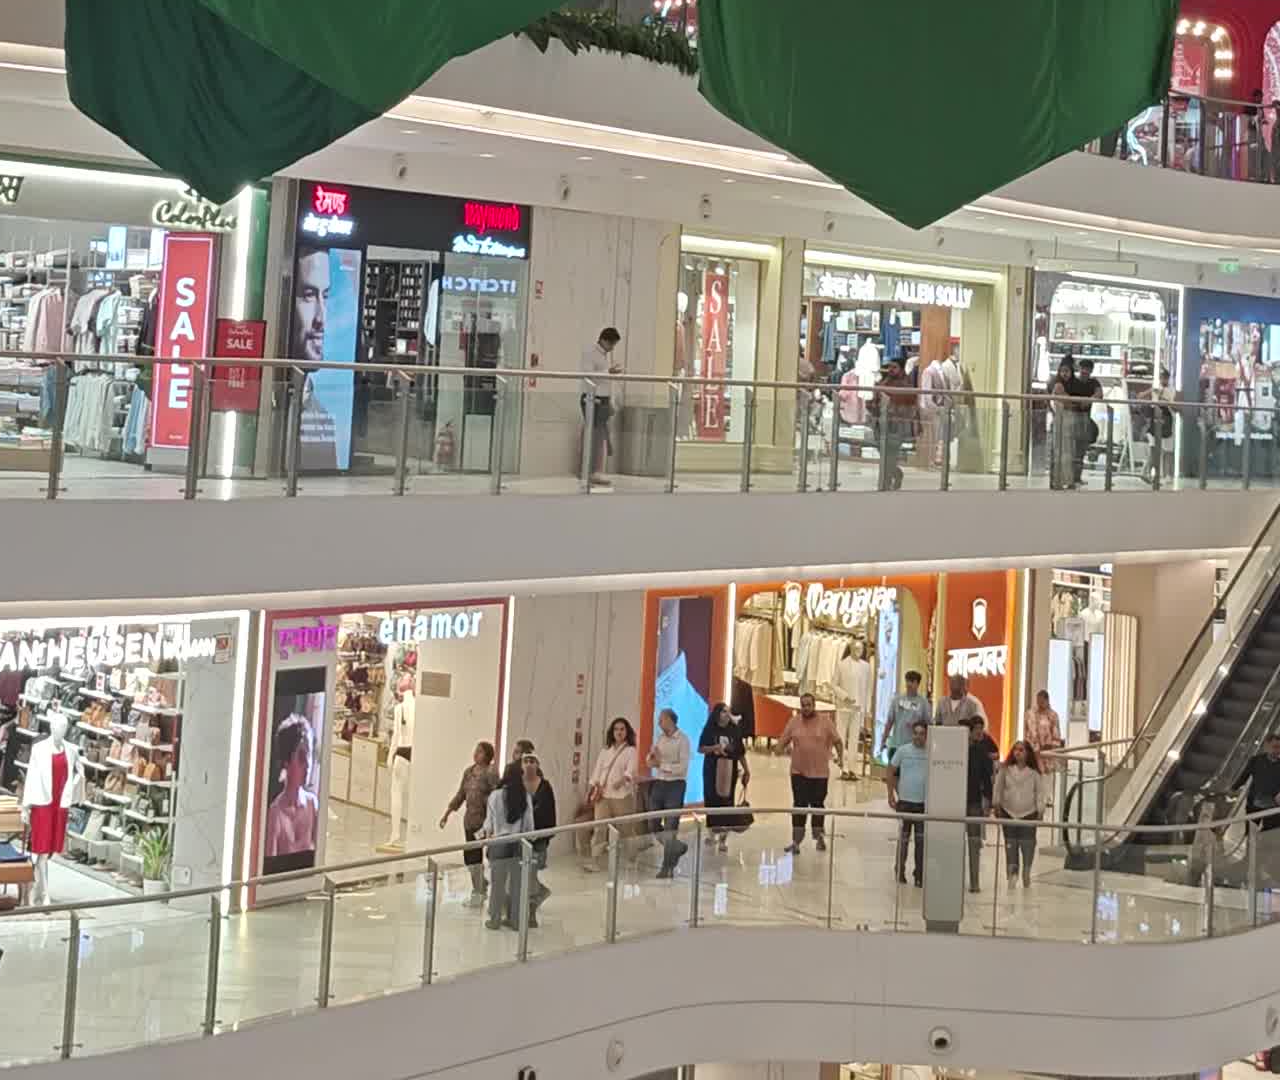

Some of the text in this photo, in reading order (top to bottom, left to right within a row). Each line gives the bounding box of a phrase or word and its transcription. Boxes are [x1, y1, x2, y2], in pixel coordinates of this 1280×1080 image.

[894, 280, 974, 309] ALLEN SOLLY
[167, 276, 196, 409] SALE
[225, 338, 255, 351] SALE
[703, 279, 723, 430] SALE
[806, 582, 898, 628] Manyavar
[379, 611, 483, 645] enamor
[45, 630, 164, 668] HEUSEN
